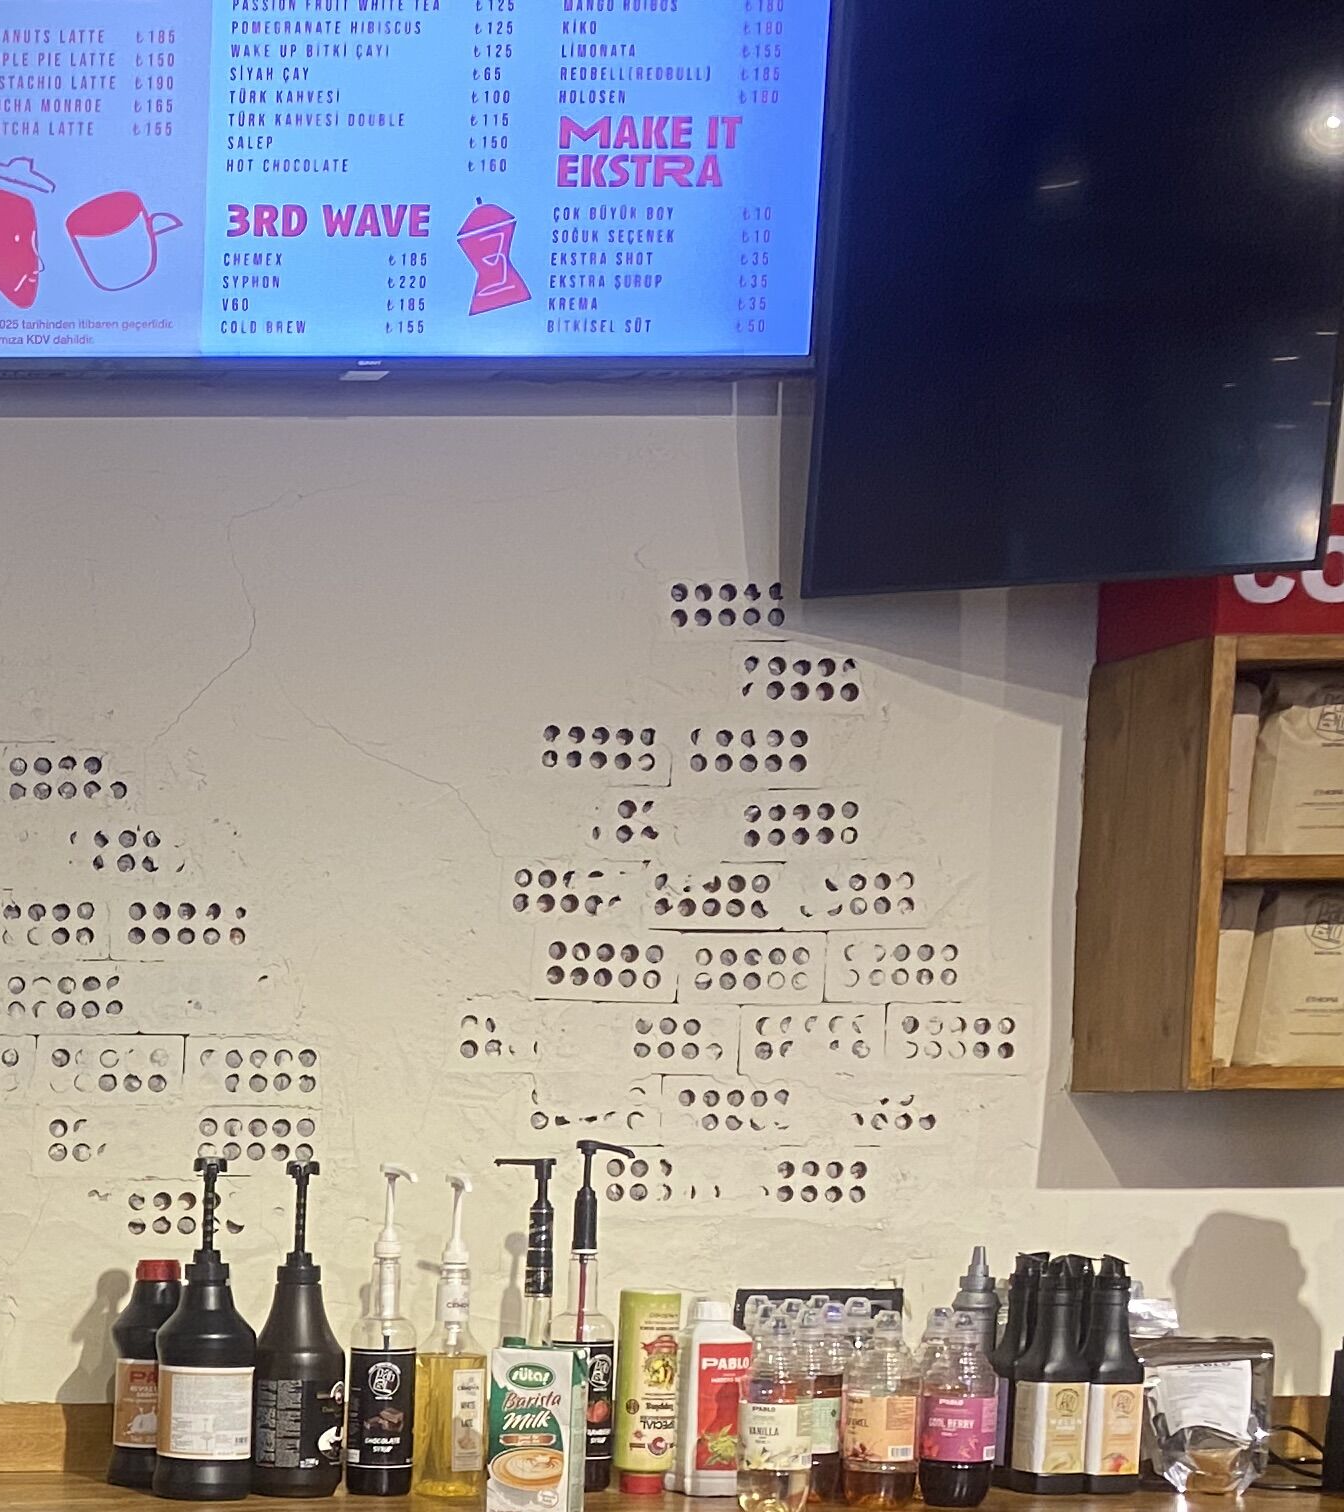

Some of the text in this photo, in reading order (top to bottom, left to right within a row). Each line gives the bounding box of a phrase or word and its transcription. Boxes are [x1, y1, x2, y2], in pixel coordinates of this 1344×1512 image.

[231, 21, 421, 34] POMEGRANATE HIBISCUS
[60, 30, 104, 43] LATTE
[231, 44, 389, 59] WAKE UP ÇAYI
[38, 53, 61, 66] PIE
[70, 53, 115, 66] LATTE
[230, 65, 309, 83] SİYAH ÇAY
[71, 76, 116, 89] LATTE
[230, 88, 266, 103] TÜRK
[559, 90, 625, 104] HOLOSEN
[228, 111, 405, 126] TÜRK DOUBLE
[49, 122, 93, 135] LATTE
[559, 115, 743, 149] MAKE IT
[227, 136, 273, 149] SALEP
[227, 159, 349, 172] HOT CHOCOLATE
[557, 154, 723, 187] EKSTRA
[226, 204, 431, 237] 3RD WAVE
[554, 207, 579, 223] ÇOK
[647, 207, 674, 220] BOY
[608, 230, 674, 245] SEÇENEK
[223, 253, 282, 266] CHEMEX
[551, 252, 653, 266] EKSTRA SHOT
[223, 276, 280, 289] SYPHON
[550, 275, 605, 289] EKSTRA
[549, 298, 597, 311] KREMA
[221, 320, 306, 334] COLD BREW
[625, 318, 651, 333] SÜT
[26, 335, 50, 344] KDV
[701, 1357, 749, 1370] PABLO
[503, 1392, 561, 1409] Barista
[503, 1410, 552, 1430] Milk
